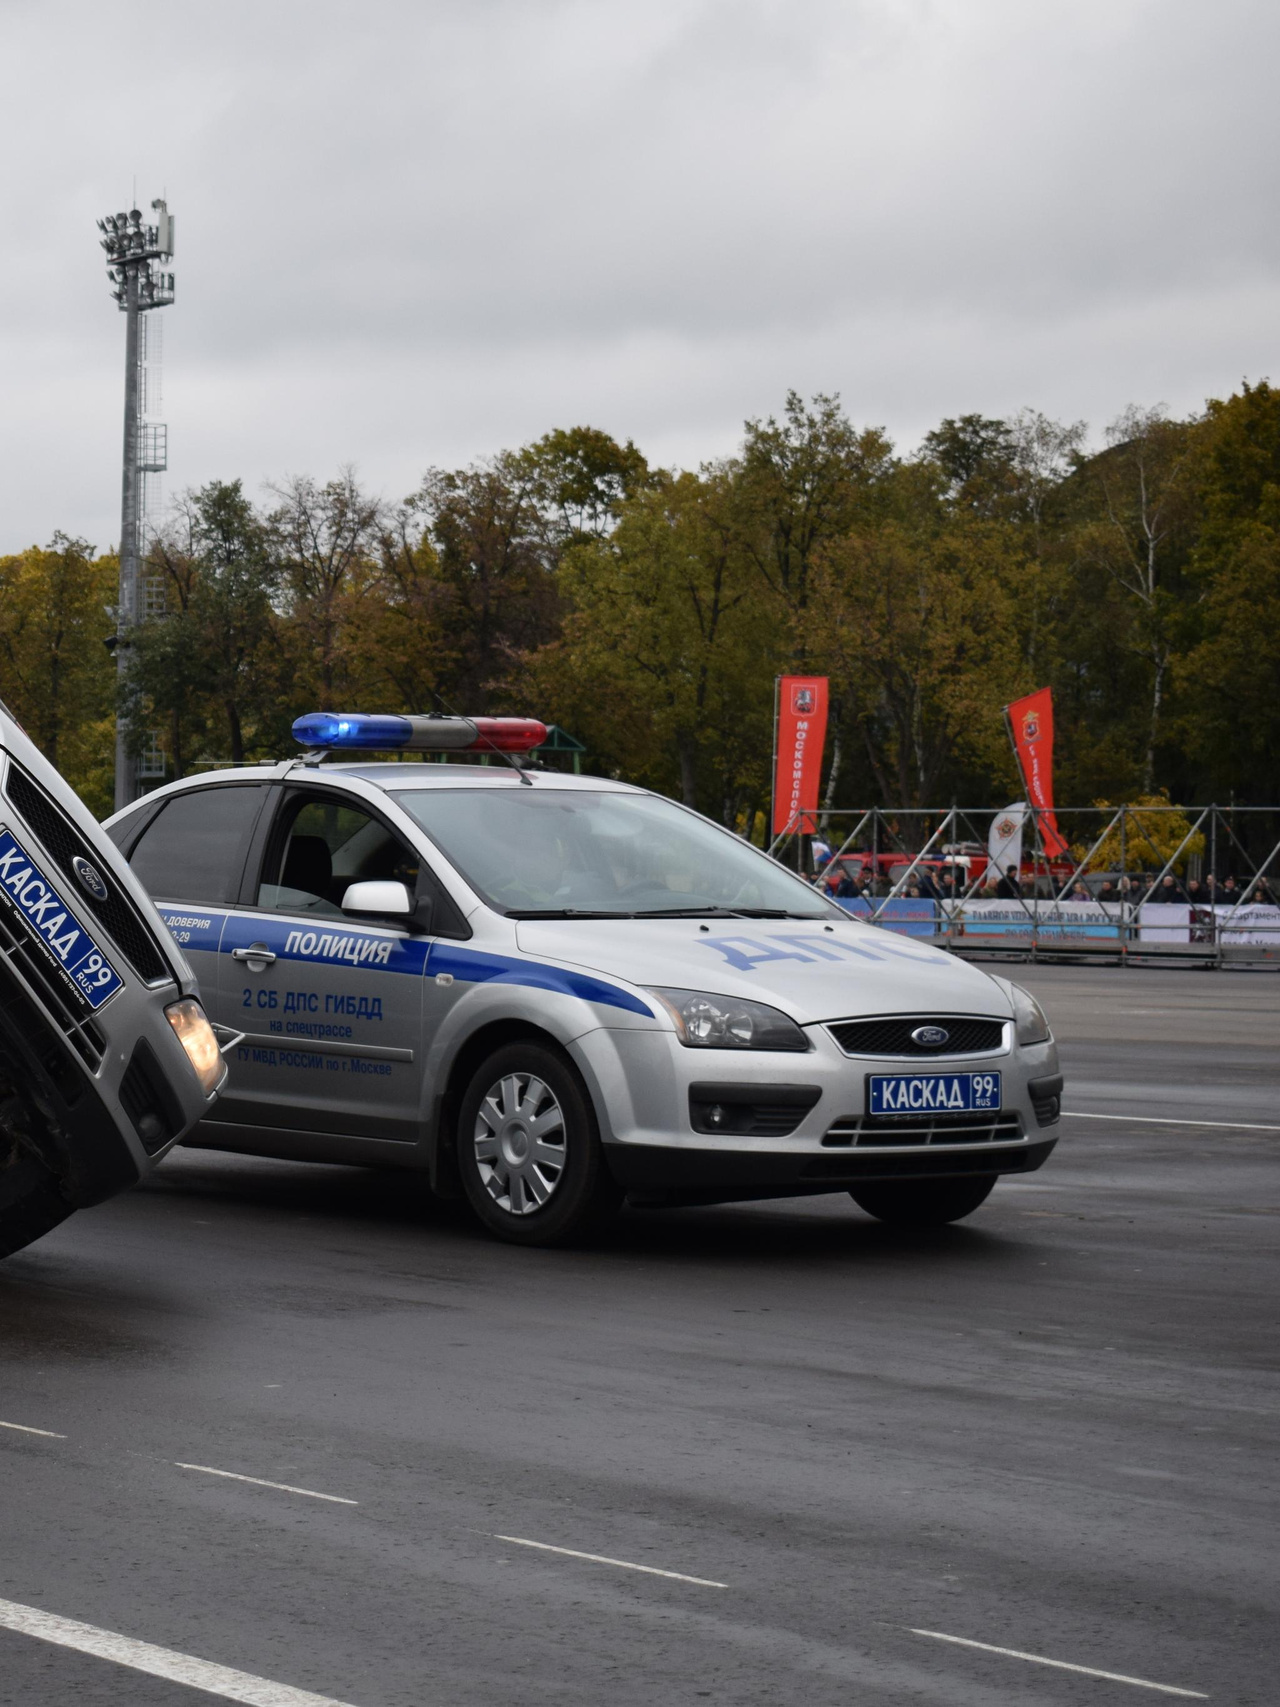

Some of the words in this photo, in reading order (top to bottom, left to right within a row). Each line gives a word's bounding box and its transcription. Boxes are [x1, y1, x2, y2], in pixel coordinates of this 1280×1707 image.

[167, 916, 211, 929] ДОВЕРИЯ
[284, 931, 394, 964] ПОЛИЦИЯ
[694, 934, 952, 971] ДПС
[76, 972, 94, 994] RUS
[82, 954, 112, 987] 99
[243, 988, 252, 1007] 2
[257, 989, 278, 1009] СБ
[284, 992, 318, 1014] ДПС
[325, 994, 383, 1021] ГИБДД
[270, 1020, 282, 1032] на
[286, 1021, 352, 1038] спецтрассе
[238, 1048, 249, 1061] ГУ
[253, 1049, 277, 1067] МВД
[280, 1052, 323, 1069] РОССИИ
[326, 1060, 339, 1071] по
[882, 1079, 964, 1109] КАСКАД
[973, 1076, 993, 1098] 99
[976, 1098, 991, 1107] RUS
